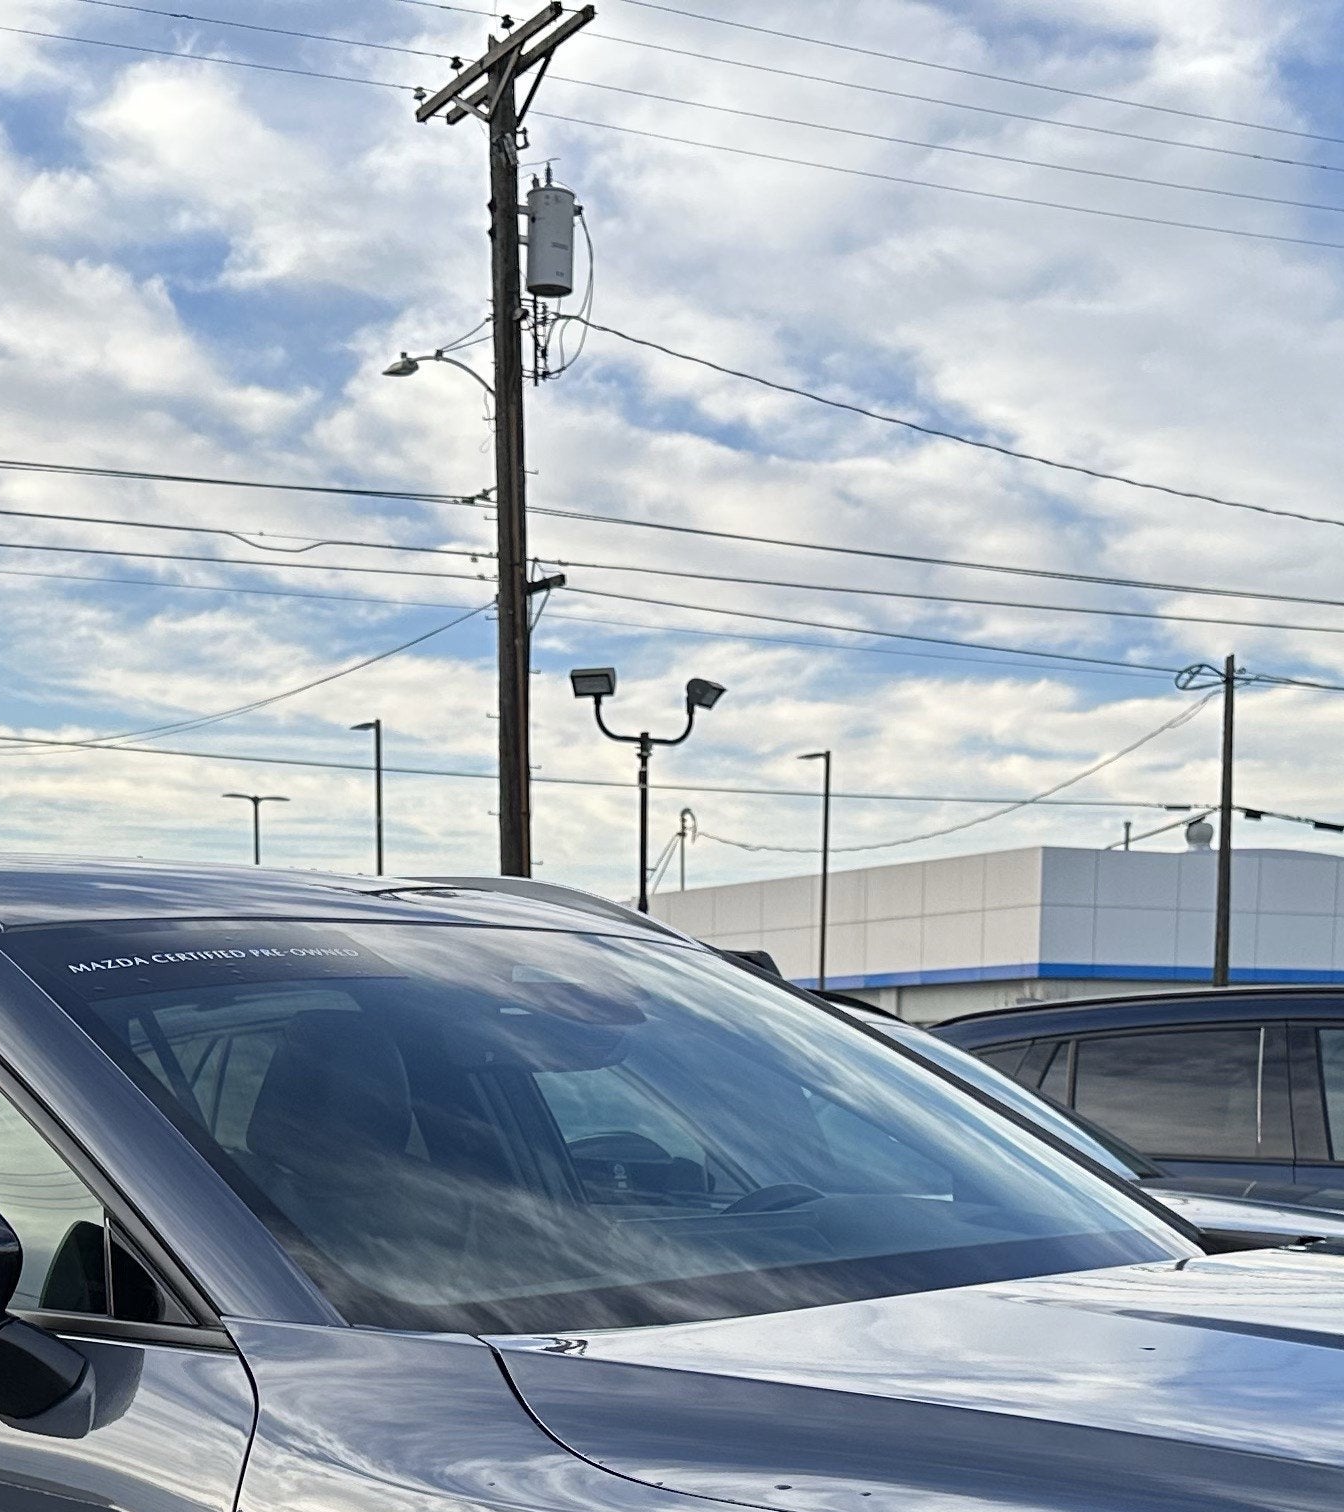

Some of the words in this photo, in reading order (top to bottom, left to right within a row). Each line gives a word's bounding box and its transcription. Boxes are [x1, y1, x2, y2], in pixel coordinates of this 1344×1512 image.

[68, 956, 149, 973] MAZDA
[151, 949, 246, 963] CERTIFIED
[249, 947, 359, 957] PRE-OWNED
